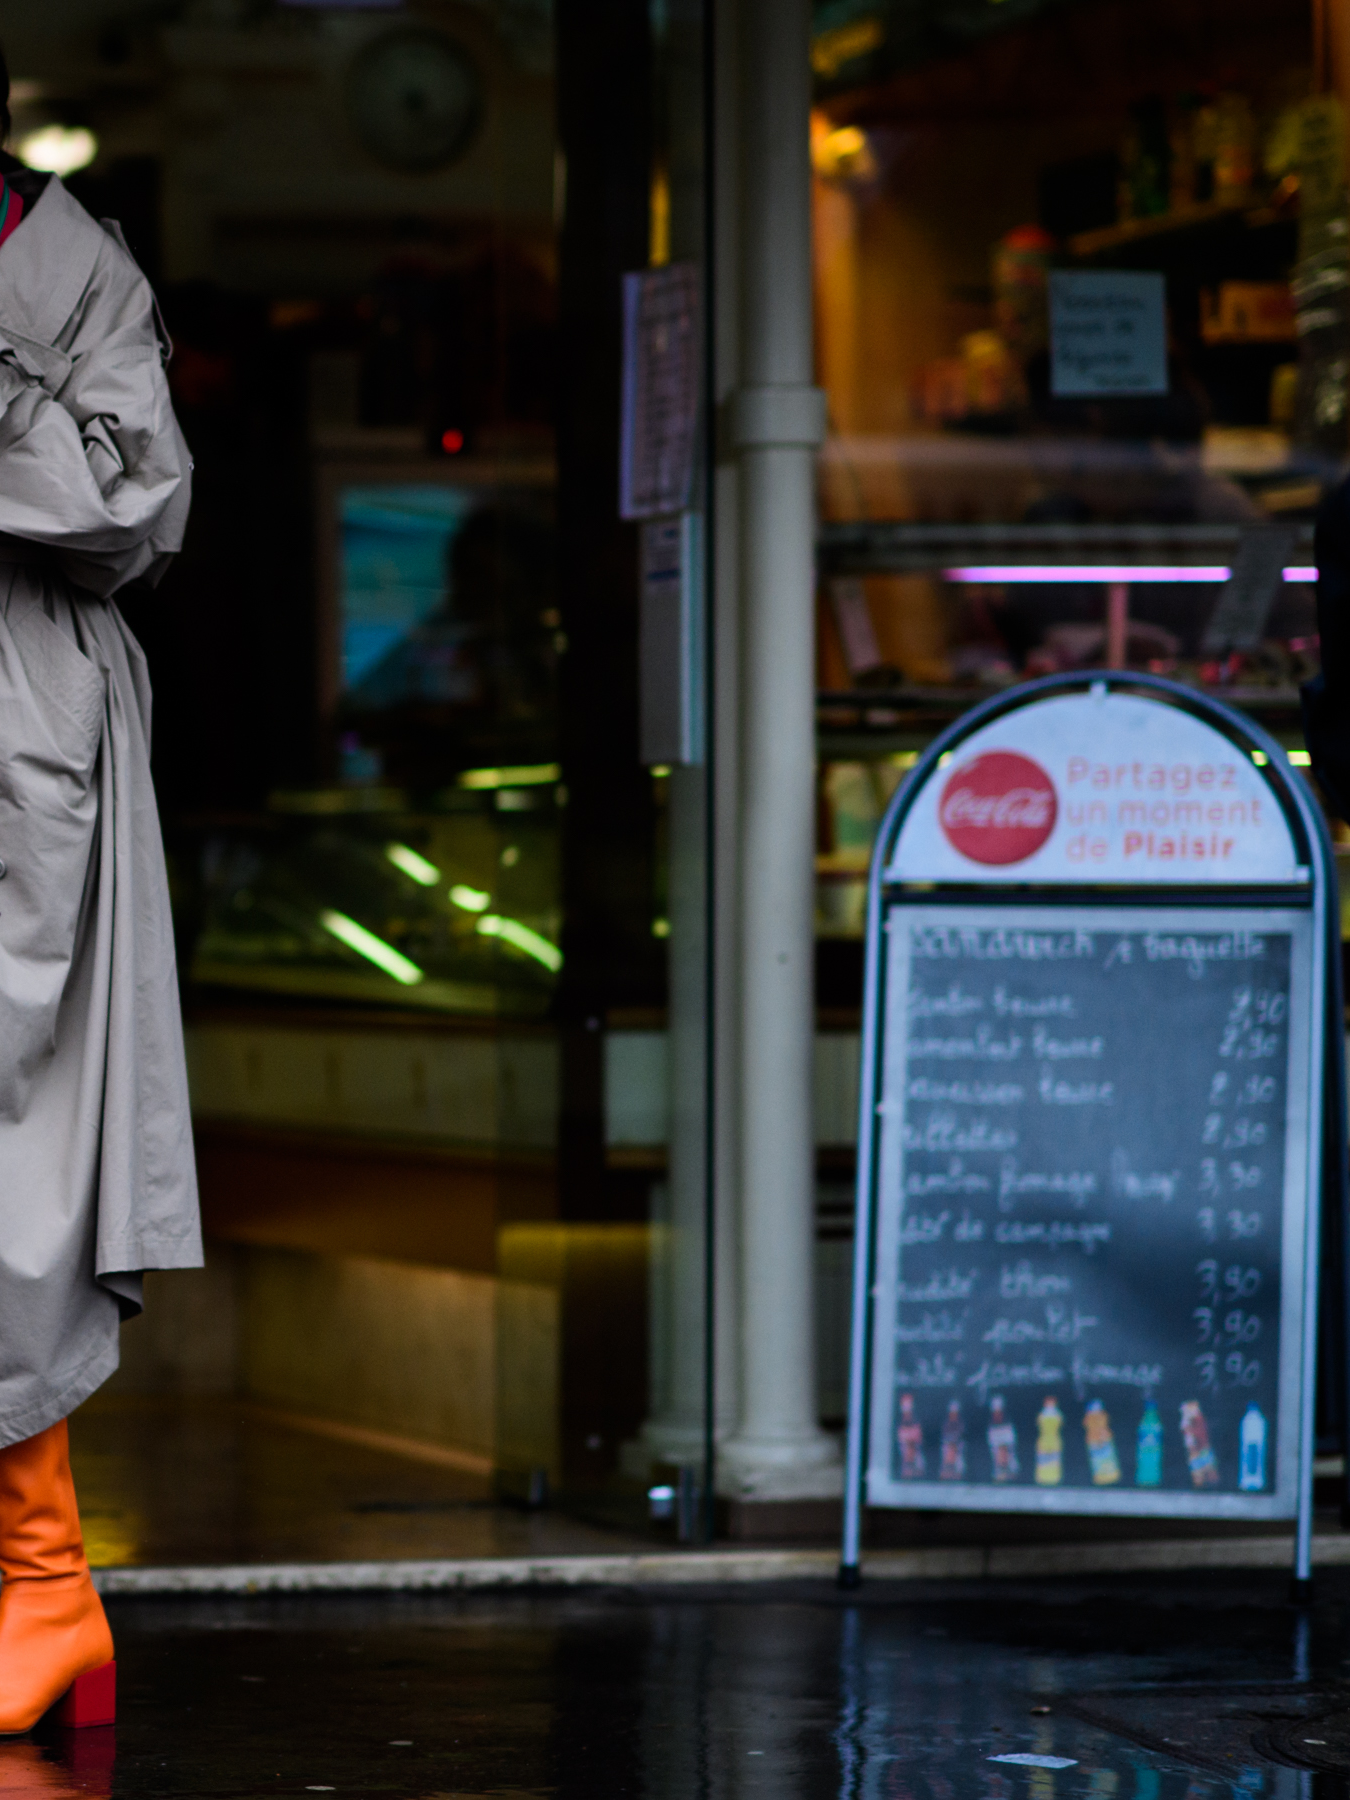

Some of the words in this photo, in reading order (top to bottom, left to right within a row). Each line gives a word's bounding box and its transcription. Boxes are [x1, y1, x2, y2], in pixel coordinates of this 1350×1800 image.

[1066, 755, 1237, 796] Partagez
[1066, 800, 1109, 827] un
[1117, 797, 1262, 827] moment
[1066, 833, 1109, 863] de
[1123, 831, 1234, 862] Plaisir
